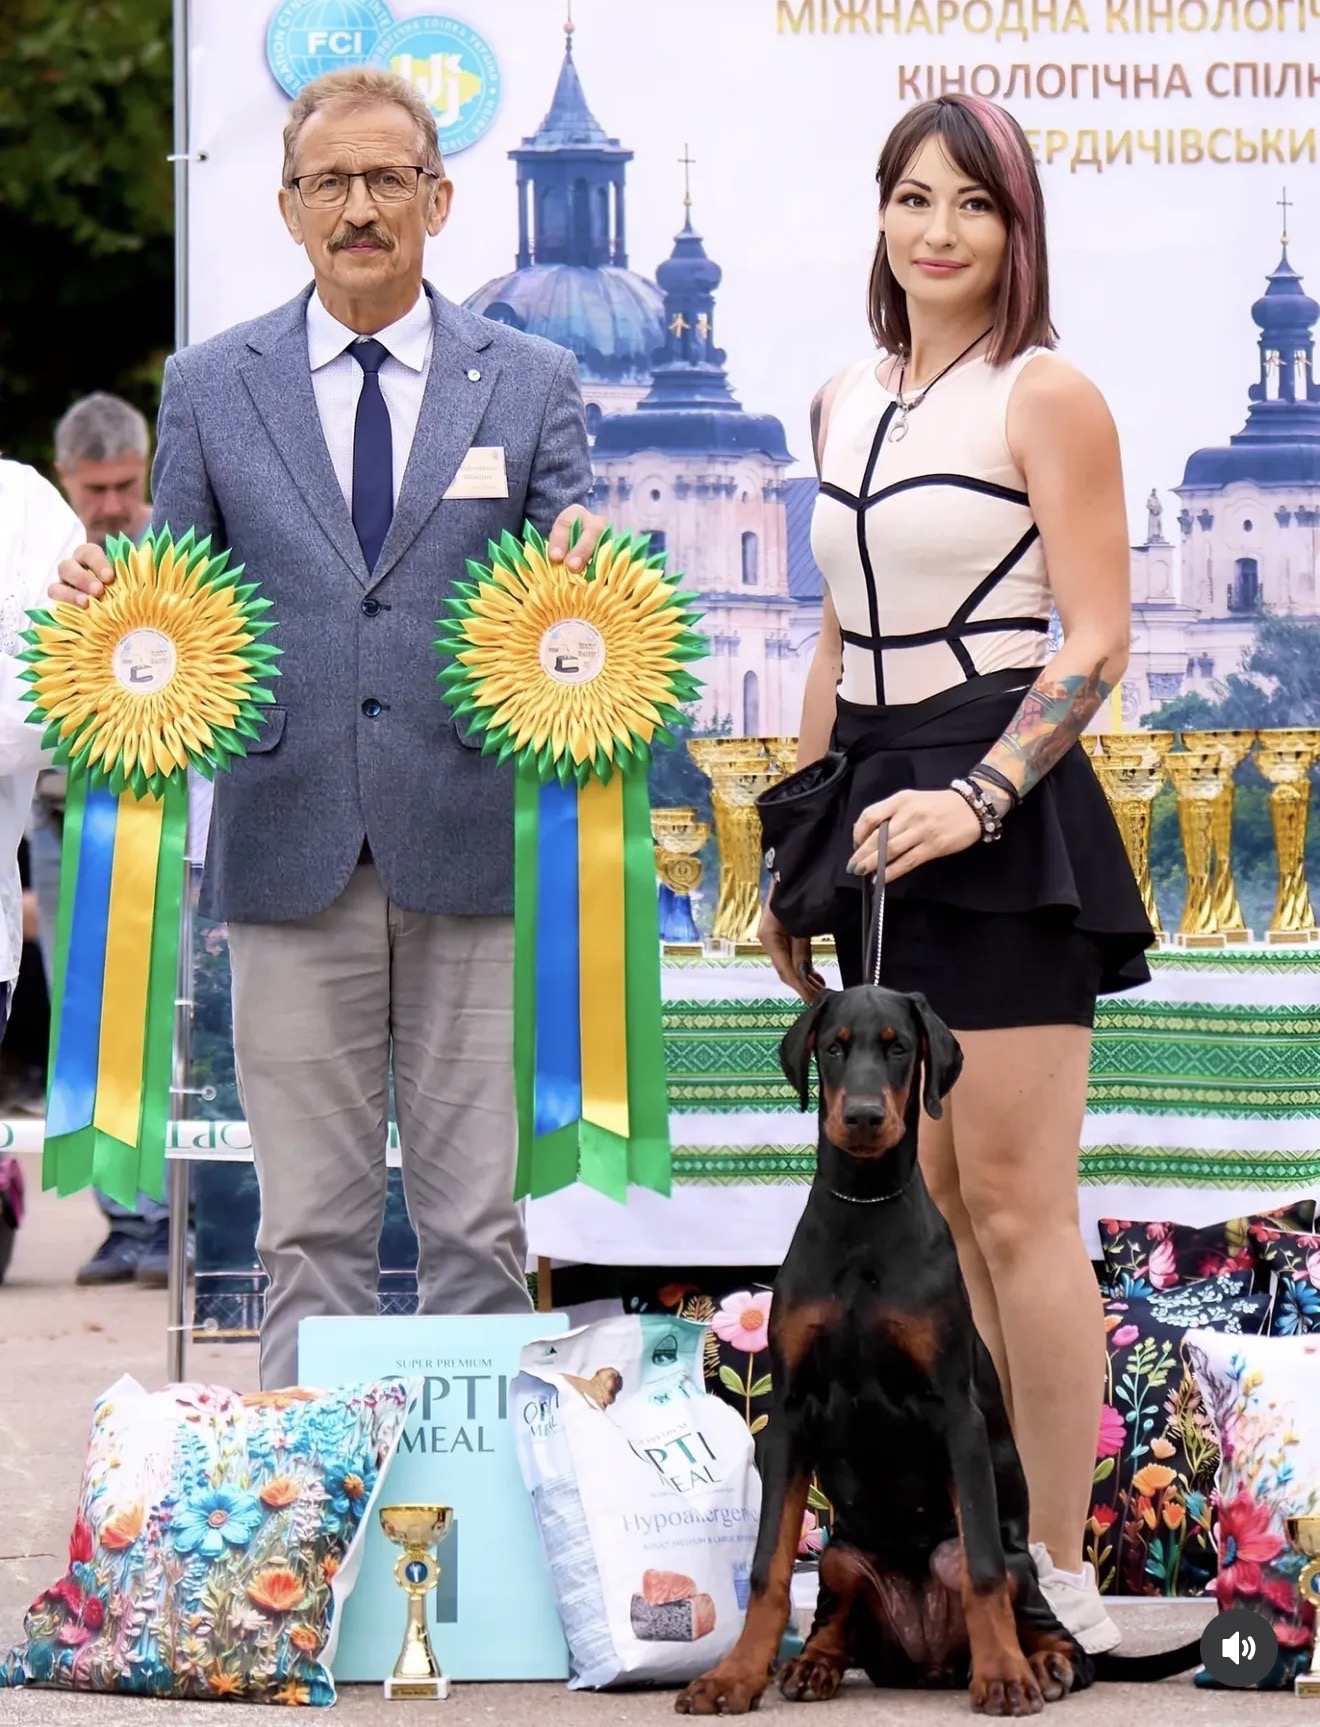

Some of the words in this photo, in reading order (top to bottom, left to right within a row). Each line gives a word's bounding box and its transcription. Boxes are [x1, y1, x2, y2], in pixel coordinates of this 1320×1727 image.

[776, 0, 1090, 41] МІЖНАРОДНА
[307, 31, 362, 55] FCI
[898, 64, 1193, 99] КІНОЛОГІЧНА
[396, 1359, 433, 1368] SUPER
[437, 1358, 492, 1368] PREMIUM
[380, 1374, 507, 1421] PTI
[396, 1426, 496, 1454] MEAL
